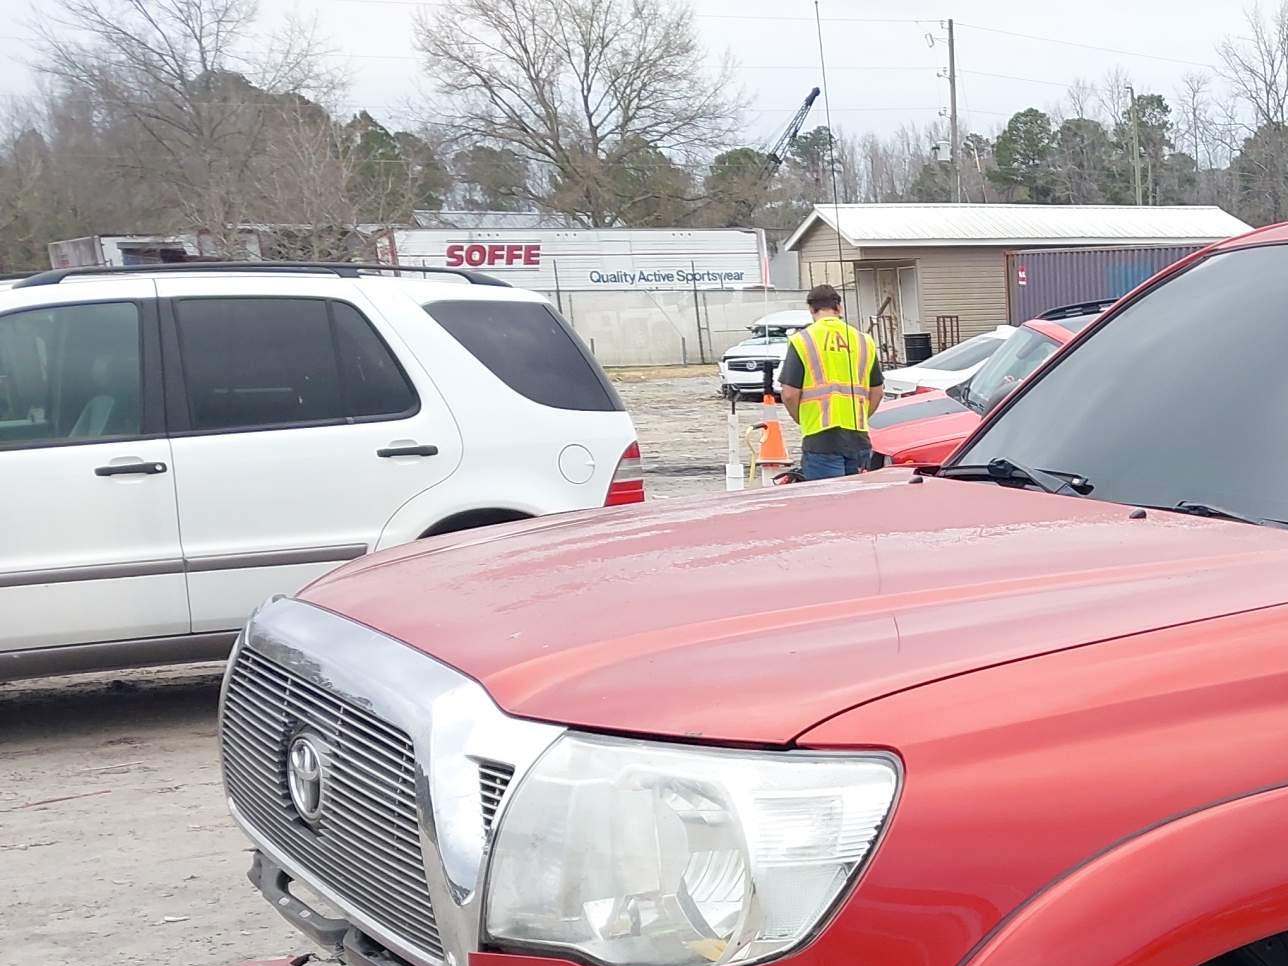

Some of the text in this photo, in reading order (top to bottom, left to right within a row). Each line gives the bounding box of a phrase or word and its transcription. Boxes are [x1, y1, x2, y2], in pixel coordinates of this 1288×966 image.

[446, 244, 541, 267] SOFFE
[590, 270, 744, 284] Quality Active Sportswear
